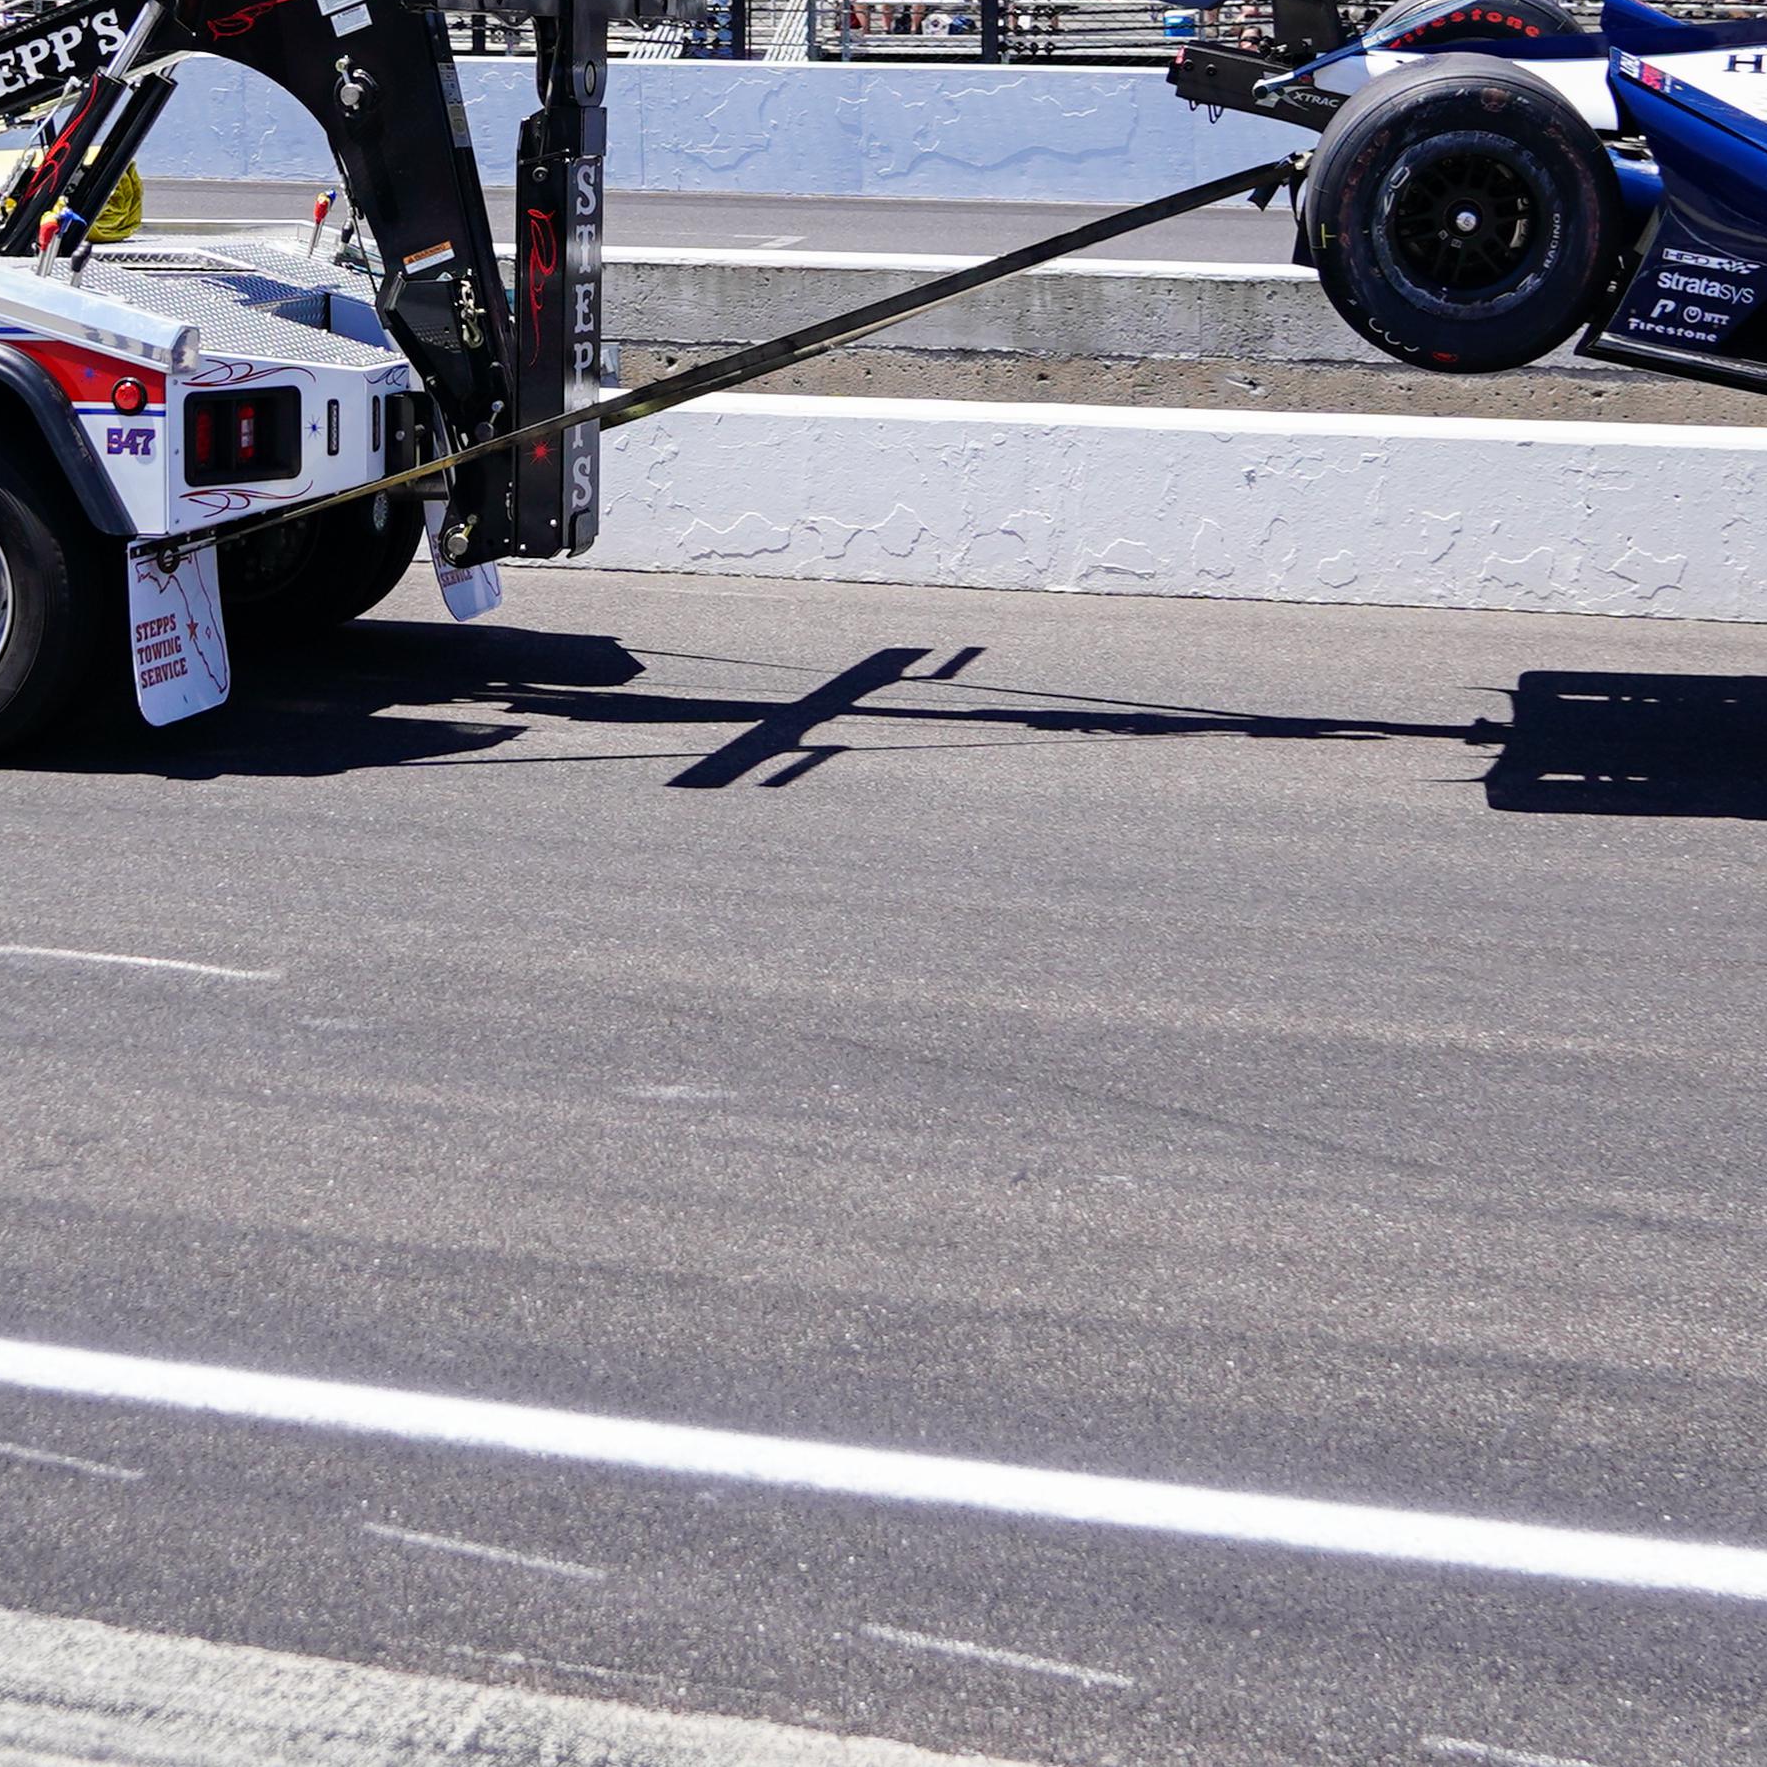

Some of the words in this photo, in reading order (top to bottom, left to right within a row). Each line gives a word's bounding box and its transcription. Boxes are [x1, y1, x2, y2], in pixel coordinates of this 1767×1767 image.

[1293, 90, 1340, 109] XTRAC
[1542, 212, 1561, 270] RACING
[1657, 271, 1755, 305] stratasys
[1628, 318, 1718, 343] Firestone
[105, 427, 157, 456] 547
[135, 612, 178, 645] STEPPS
[137, 634, 183, 666] TOWING
[139, 655, 189, 690] SERVICE
